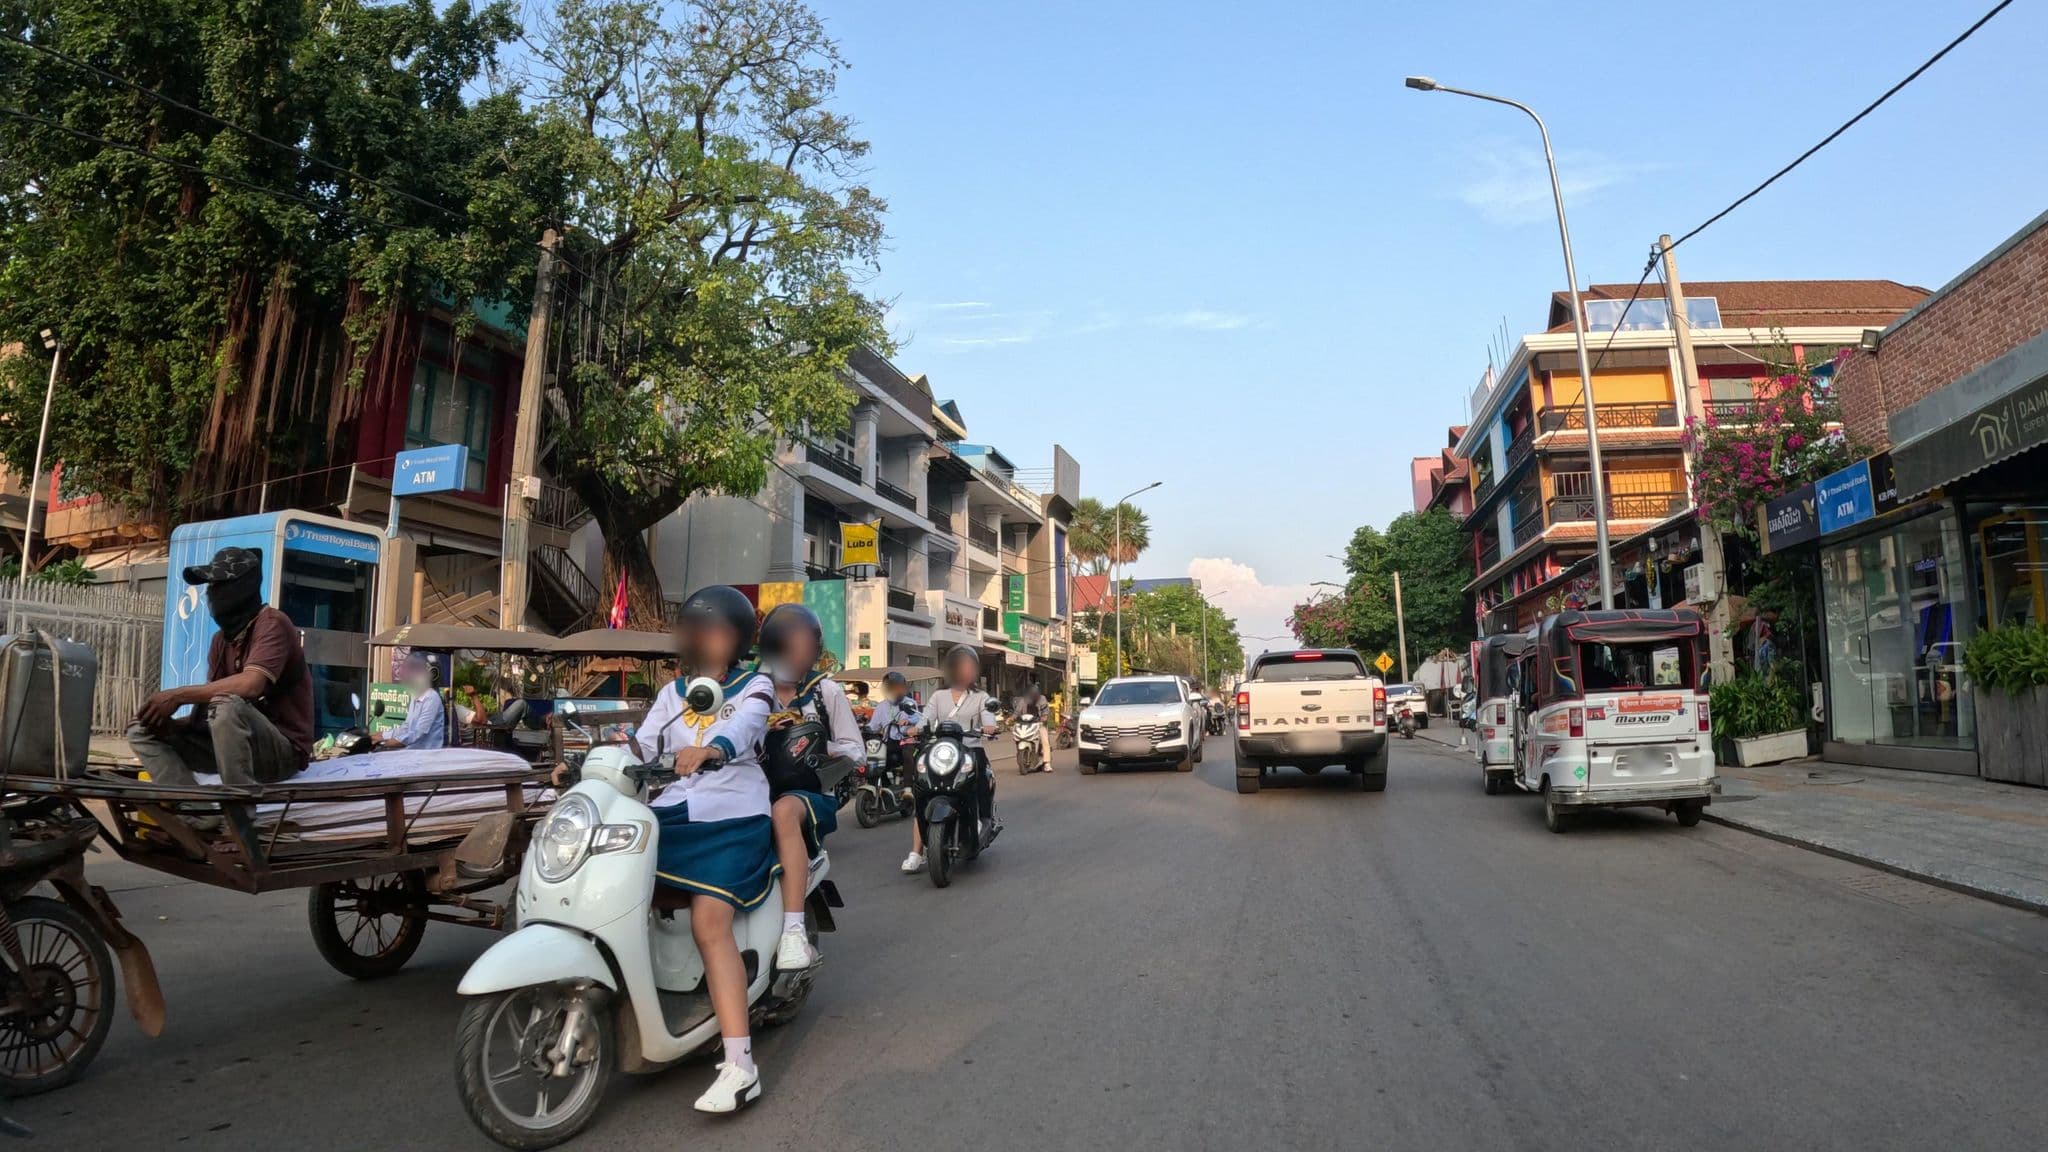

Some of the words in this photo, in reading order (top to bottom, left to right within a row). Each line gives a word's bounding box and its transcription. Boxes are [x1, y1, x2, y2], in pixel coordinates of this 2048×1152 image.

[413, 470, 436, 485] ATM
[1837, 500, 1854, 519] ATM
[847, 540, 866, 549] Lub
[1253, 715, 1371, 726] RANGER
